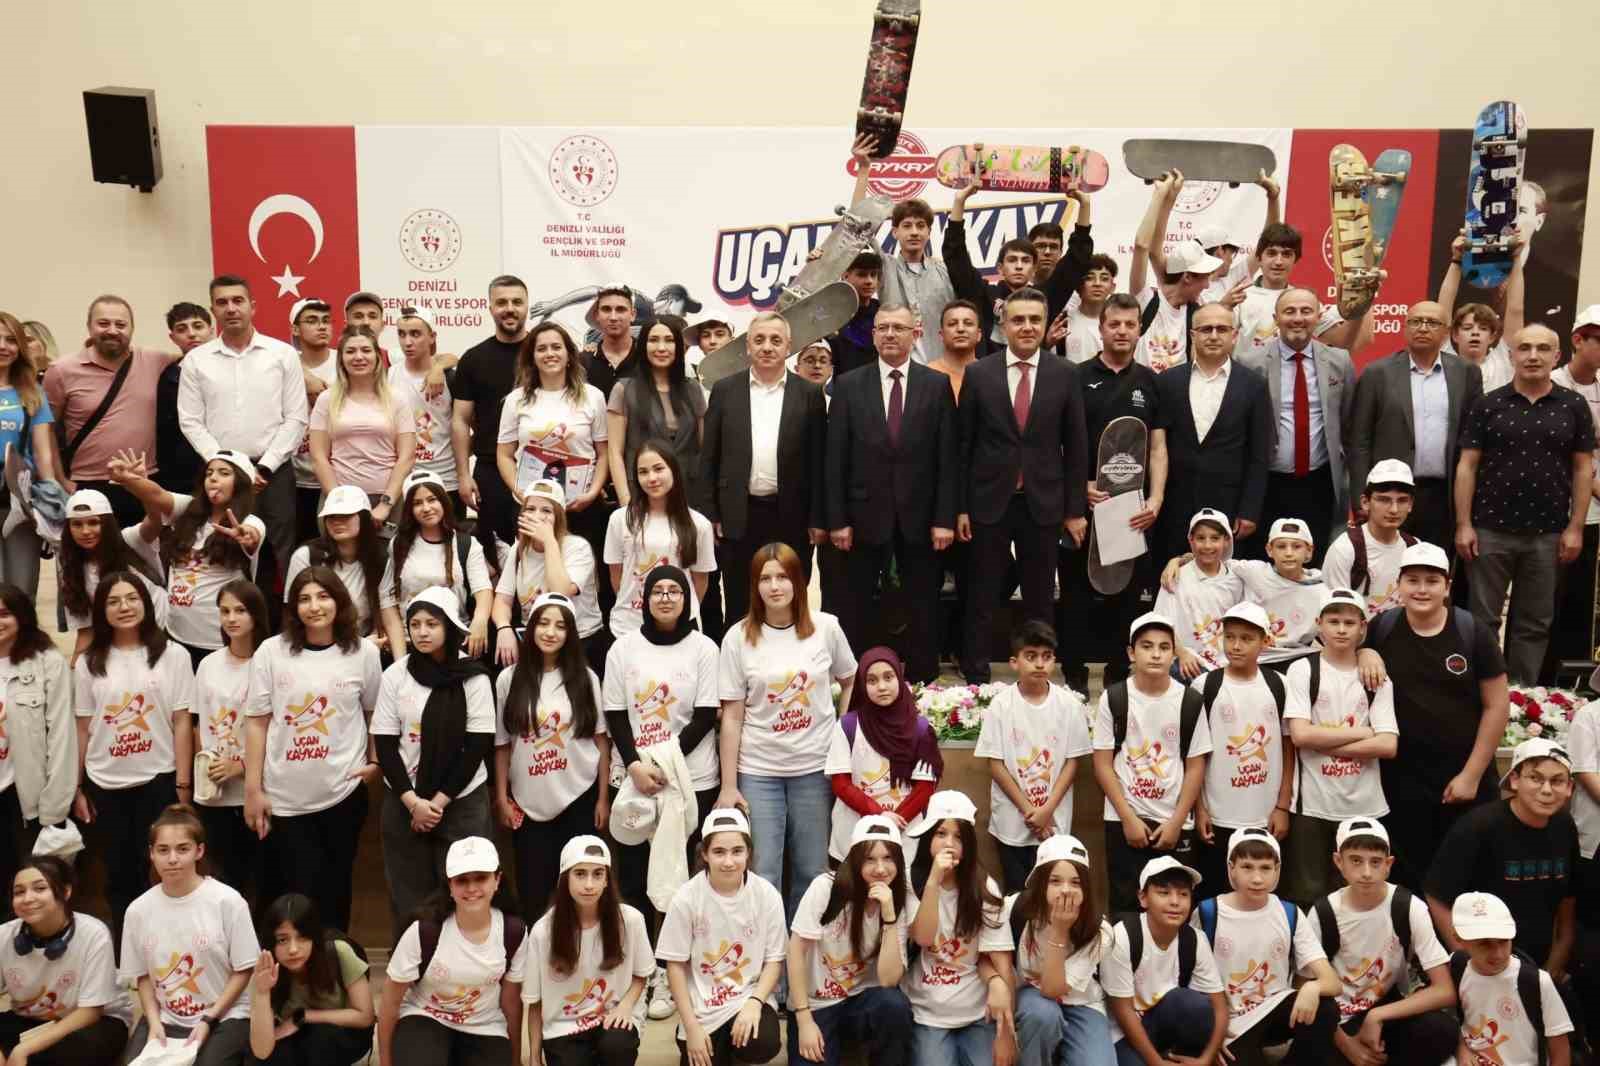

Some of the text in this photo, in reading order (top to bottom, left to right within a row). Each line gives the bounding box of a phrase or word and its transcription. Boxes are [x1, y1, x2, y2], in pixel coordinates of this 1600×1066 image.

[585, 238, 597, 246] VE
[600, 238, 626, 247] SPOR
[408, 278, 457, 292] DENİZLİ
[435, 299, 451, 309] VE
[454, 298, 487, 309] SPOR
[1373, 304, 1408, 316] SPOR
[435, 312, 482, 327] RLÜĞÜ
[109, 739, 152, 757] KAYKAY
[286, 746, 329, 761] KAYKAY
[528, 758, 567, 776] KAYKAY
[1231, 771, 1267, 788] KAYKAY
